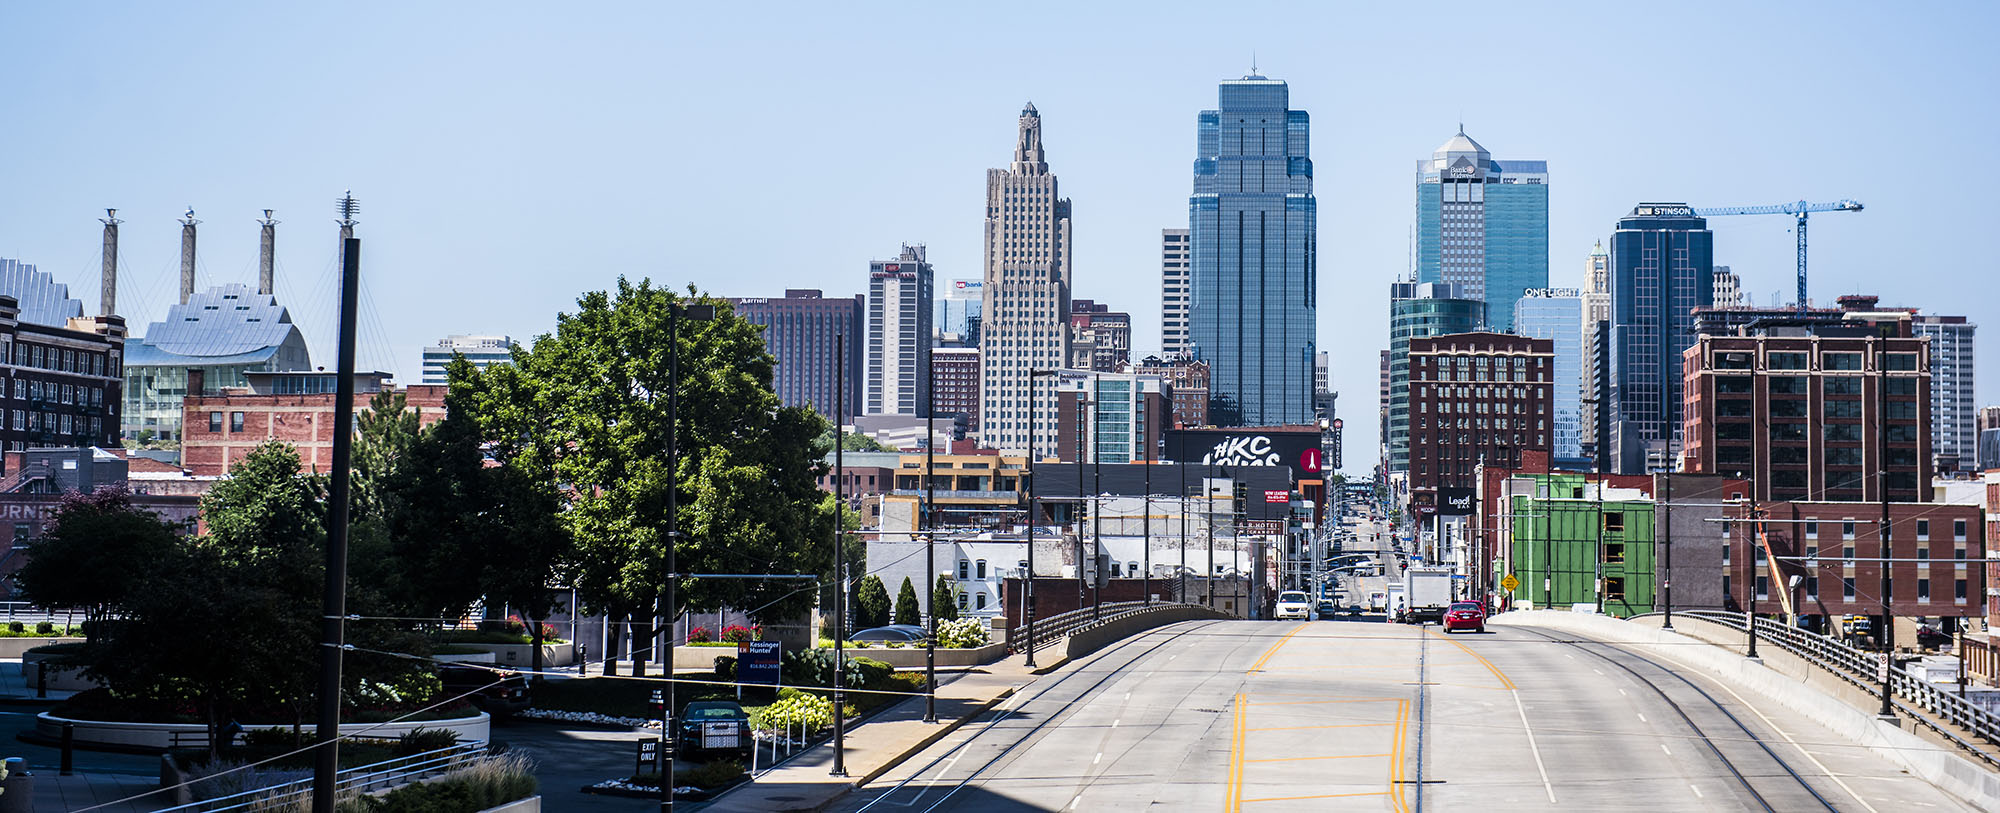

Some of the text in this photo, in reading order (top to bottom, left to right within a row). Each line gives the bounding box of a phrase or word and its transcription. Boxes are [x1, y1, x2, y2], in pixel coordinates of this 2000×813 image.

[1654, 207, 1691, 215] STINSON
[1213, 436, 1271, 460] #KC
[642, 743, 655, 751] EXIT
